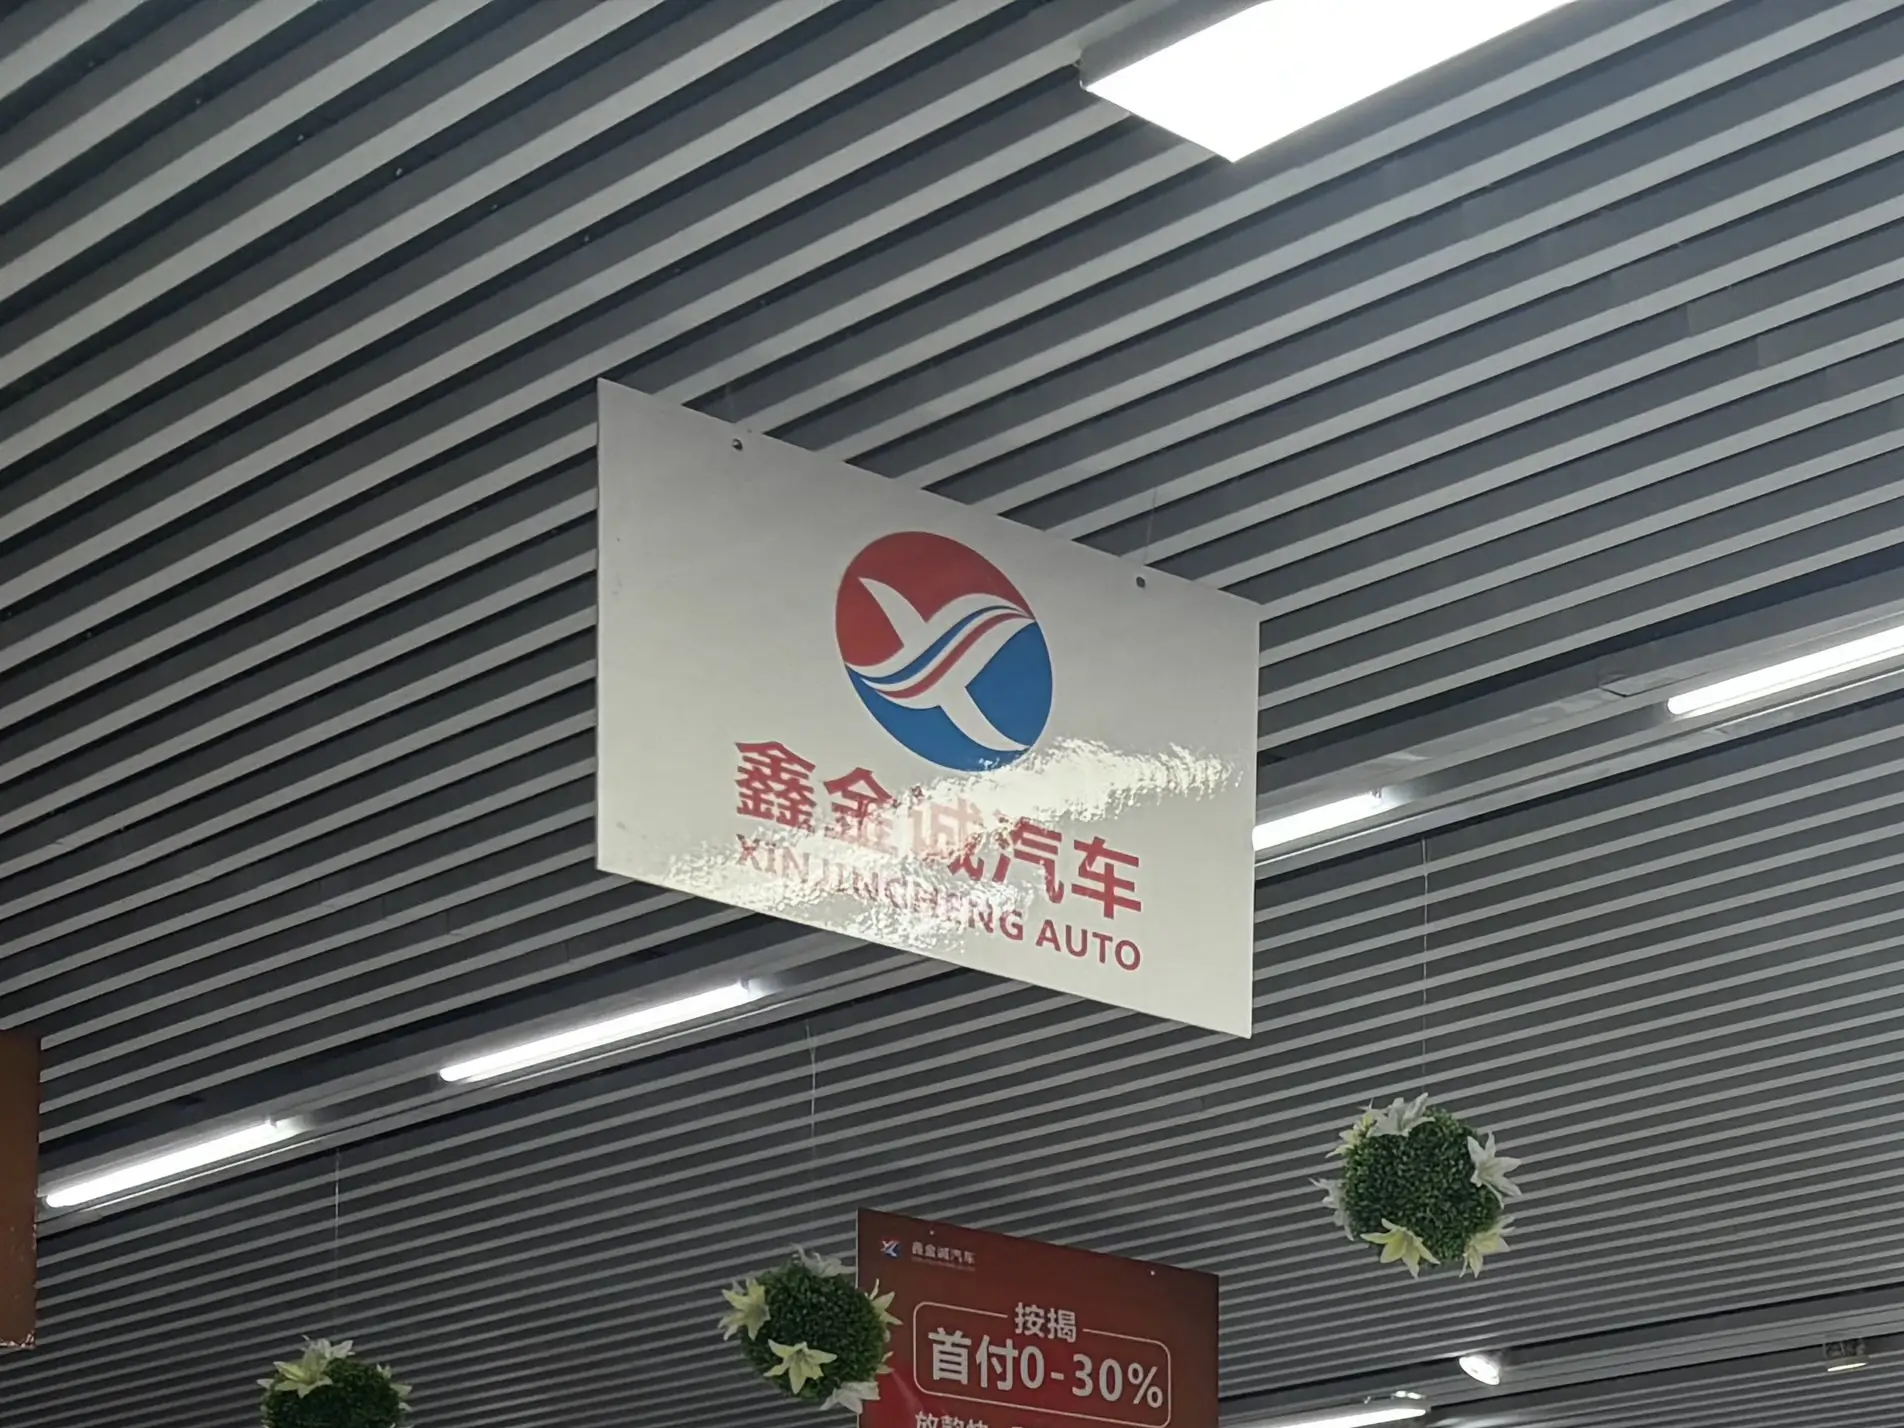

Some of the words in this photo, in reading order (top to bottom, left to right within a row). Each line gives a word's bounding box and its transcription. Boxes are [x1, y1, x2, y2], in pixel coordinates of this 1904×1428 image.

[734, 740, 1142, 920] 鑫金诚汽车
[1035, 919, 1142, 972] AUTO
[1014, 1301, 1078, 1343] 按揭
[928, 1326, 1165, 1410] 首付0-30%
